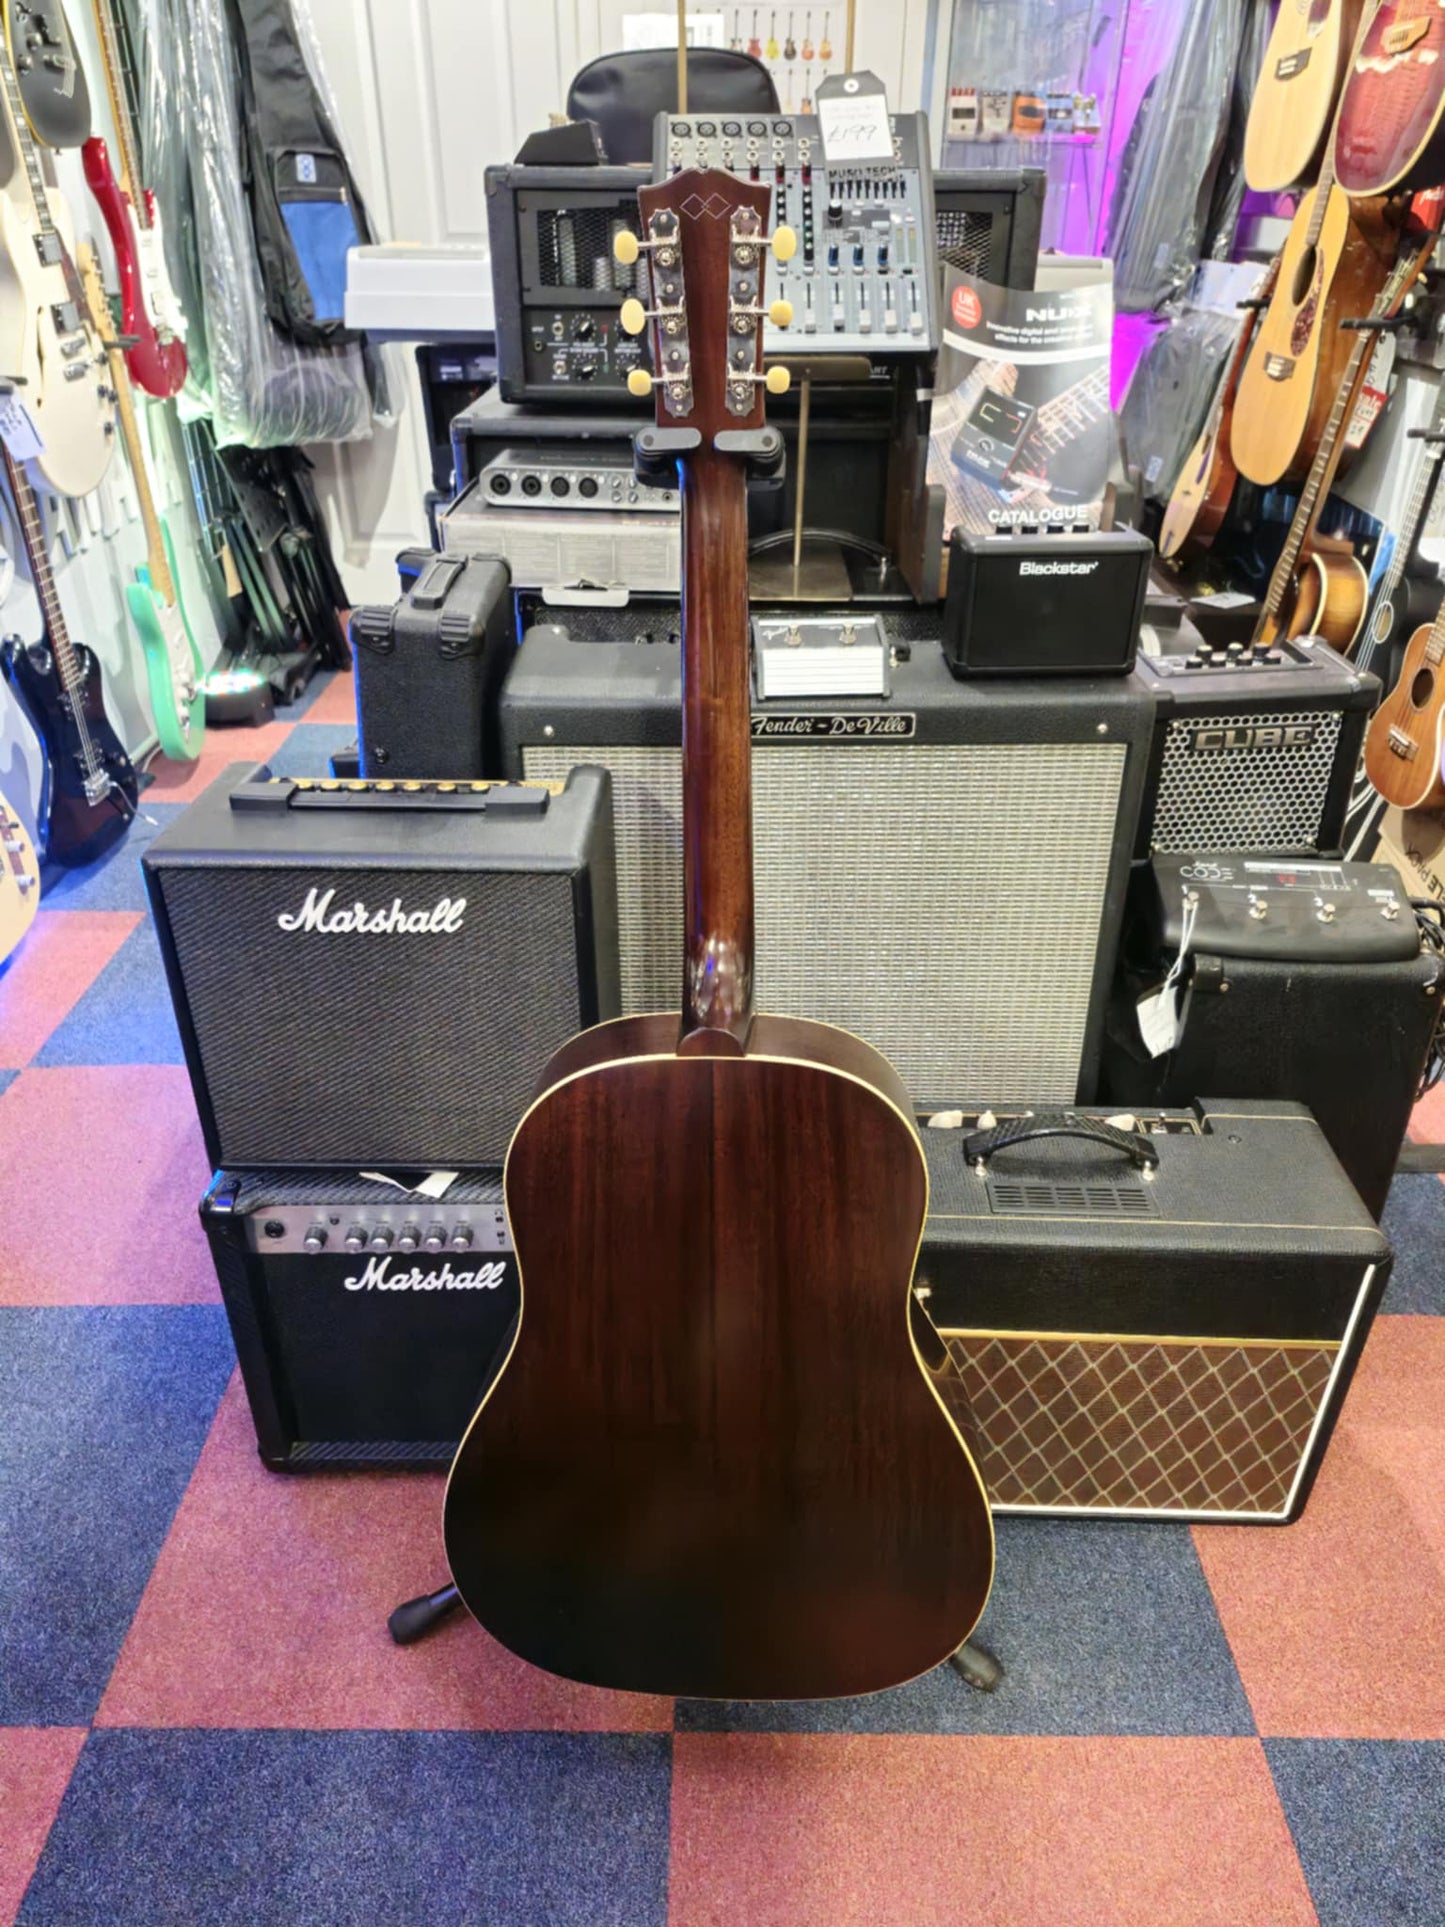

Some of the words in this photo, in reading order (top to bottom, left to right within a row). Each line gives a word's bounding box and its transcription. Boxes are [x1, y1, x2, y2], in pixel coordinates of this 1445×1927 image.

[959, 291, 974, 308] UK
[988, 505, 1088, 524] CATALOGUE
[1019, 561, 1098, 576] Blackstar
[751, 716, 815, 736] Fender
[1196, 726, 1312, 750] CUBE
[1180, 866, 1234, 881] CODE
[277, 887, 467, 934] Marshall
[344, 1255, 507, 1292] Marshall
